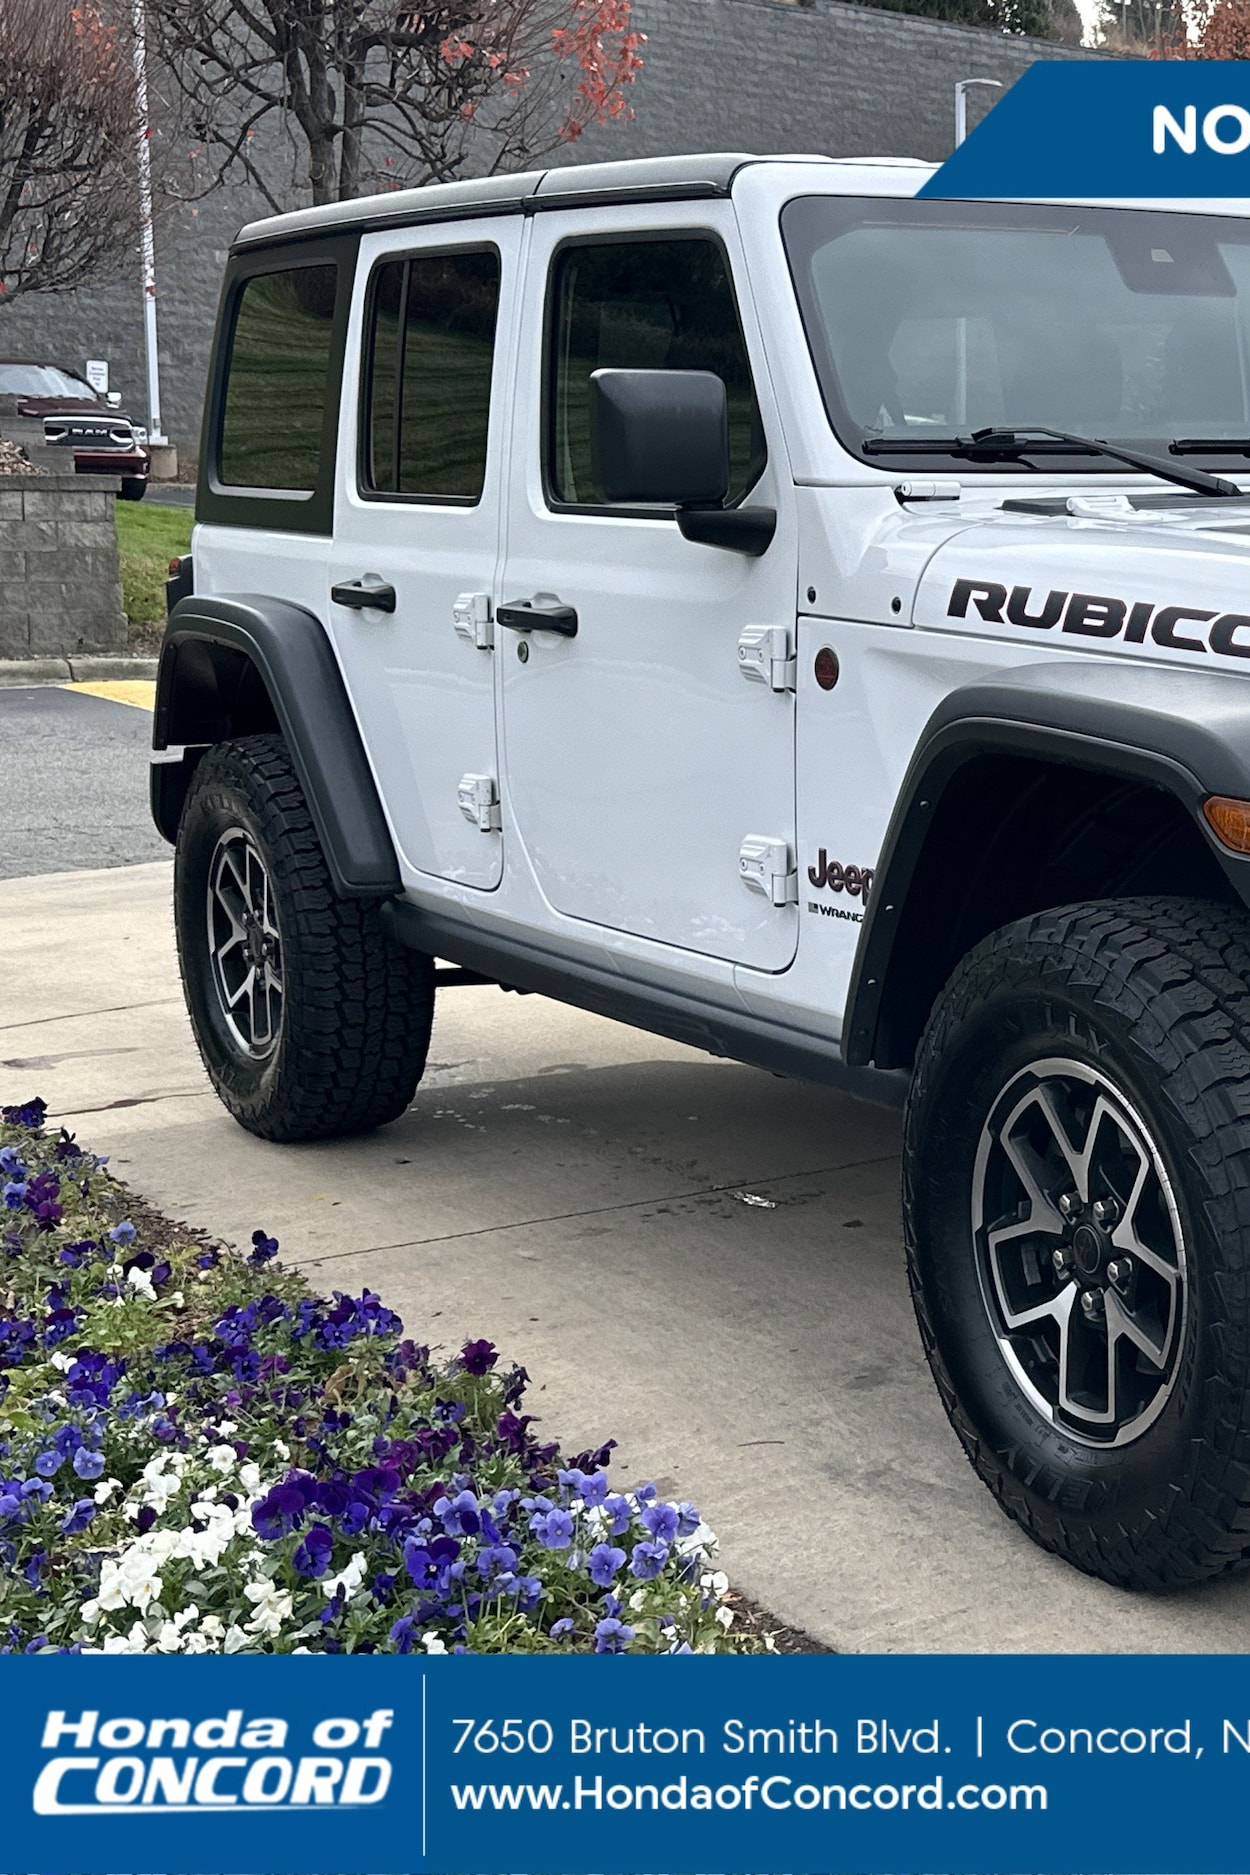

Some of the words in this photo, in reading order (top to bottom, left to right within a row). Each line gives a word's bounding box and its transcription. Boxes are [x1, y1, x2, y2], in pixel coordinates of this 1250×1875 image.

[72, 428, 108, 437] RAM
[808, 848, 876, 906] Jeep
[819, 904, 864, 923] WRANG
